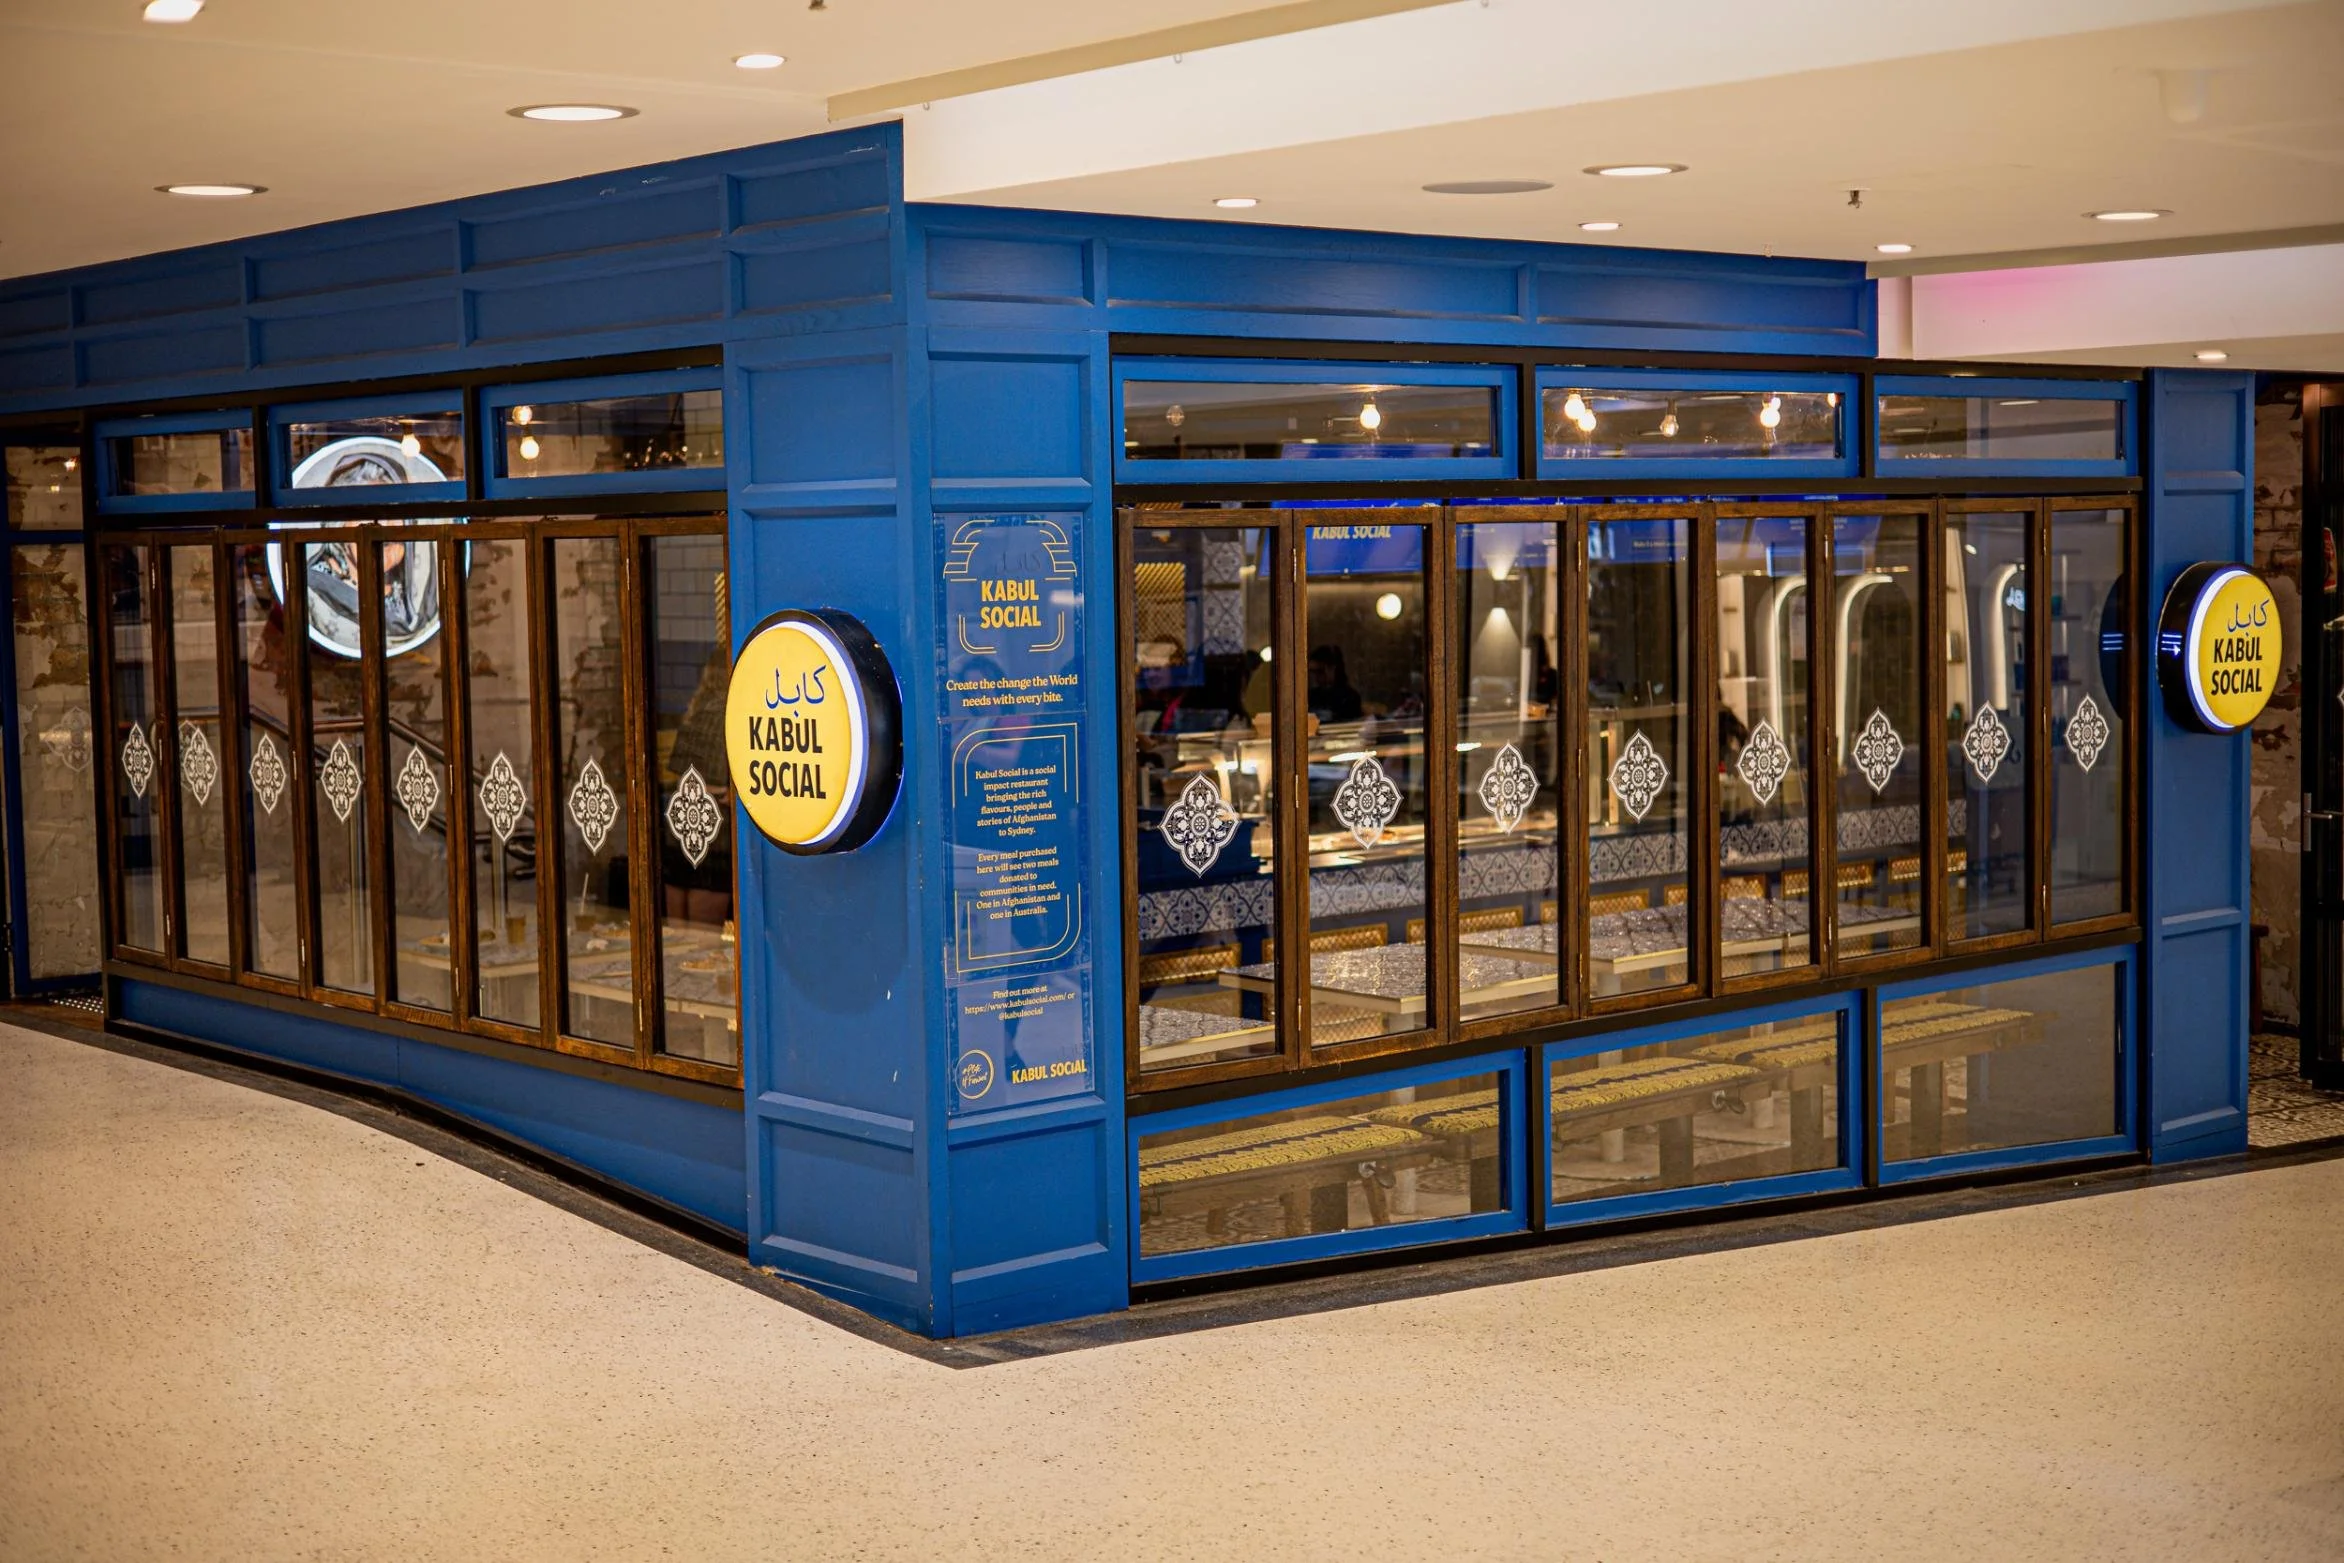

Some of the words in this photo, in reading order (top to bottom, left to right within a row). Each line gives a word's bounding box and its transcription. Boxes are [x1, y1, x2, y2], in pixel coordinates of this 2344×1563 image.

[1312, 526, 1350, 540] KABUL
[1352, 525, 1392, 539] SOCIAL
[981, 579, 1040, 602] KABUL
[980, 605, 1042, 629] SOCIAL
[2213, 637, 2263, 664] KABUL
[946, 680, 978, 692] Create
[979, 678, 996, 689] the
[996, 677, 1032, 690] change
[1032, 676, 1048, 687] the
[1048, 674, 1078, 685] World
[2211, 668, 2262, 696] SOCIAL
[962, 695, 991, 707] needs
[993, 693, 1015, 705] with
[1016, 693, 1043, 705] every
[1043, 691, 1064, 703] bite.
[749, 716, 823, 754] KABUL
[749, 759, 827, 800] SOCIAL
[976, 770, 998, 779] Kabul
[998, 768, 1020, 777] Social
[1022, 768, 1029, 776] is
[1035, 765, 1056, 774] social
[984, 782, 1009, 792] impact
[1011, 779, 1048, 788] restaurant
[986, 793, 1018, 803] bringing
[1019, 791, 1031, 799] the
[1031, 789, 1047, 798] rich
[981, 805, 1012, 814] flavours,
[1013, 802, 1037, 813] people
[1038, 800, 1052, 809] and
[977, 817, 1002, 827] stories
[1003, 815, 1011, 823] of
[1012, 813, 1057, 824] Afghanistan
[998, 828, 1007, 836] to
[1007, 826, 1036, 837] Sydney.
[978, 853, 999, 862] Every
[1000, 850, 1018, 859] meal
[1019, 846, 1057, 859] purchased
[976, 866, 993, 874] here
[995, 863, 1009, 872] will
[1009, 863, 1022, 871] see
[1022, 861, 1036, 869] two
[1037, 858, 1059, 868] meals
[999, 873, 1029, 883] donated
[980, 885, 1028, 897] communities
[1037, 881, 1057, 890] need.
[976, 901, 992, 909] One
[993, 899, 1000, 907] in
[1001, 896, 1046, 908] Afghanistan
[1047, 892, 1061, 901] and
[990, 912, 1004, 920] one
[1004, 910, 1012, 918] in
[1013, 905, 1048, 917] Australia.
[992, 989, 1008, 999] Find
[1009, 989, 1021, 997] out
[1021, 987, 1040, 995] more
[1040, 985, 1048, 993] at
[1011, 1065, 1048, 1084] KABUL
[1050, 1058, 1087, 1078] SOCIAL
